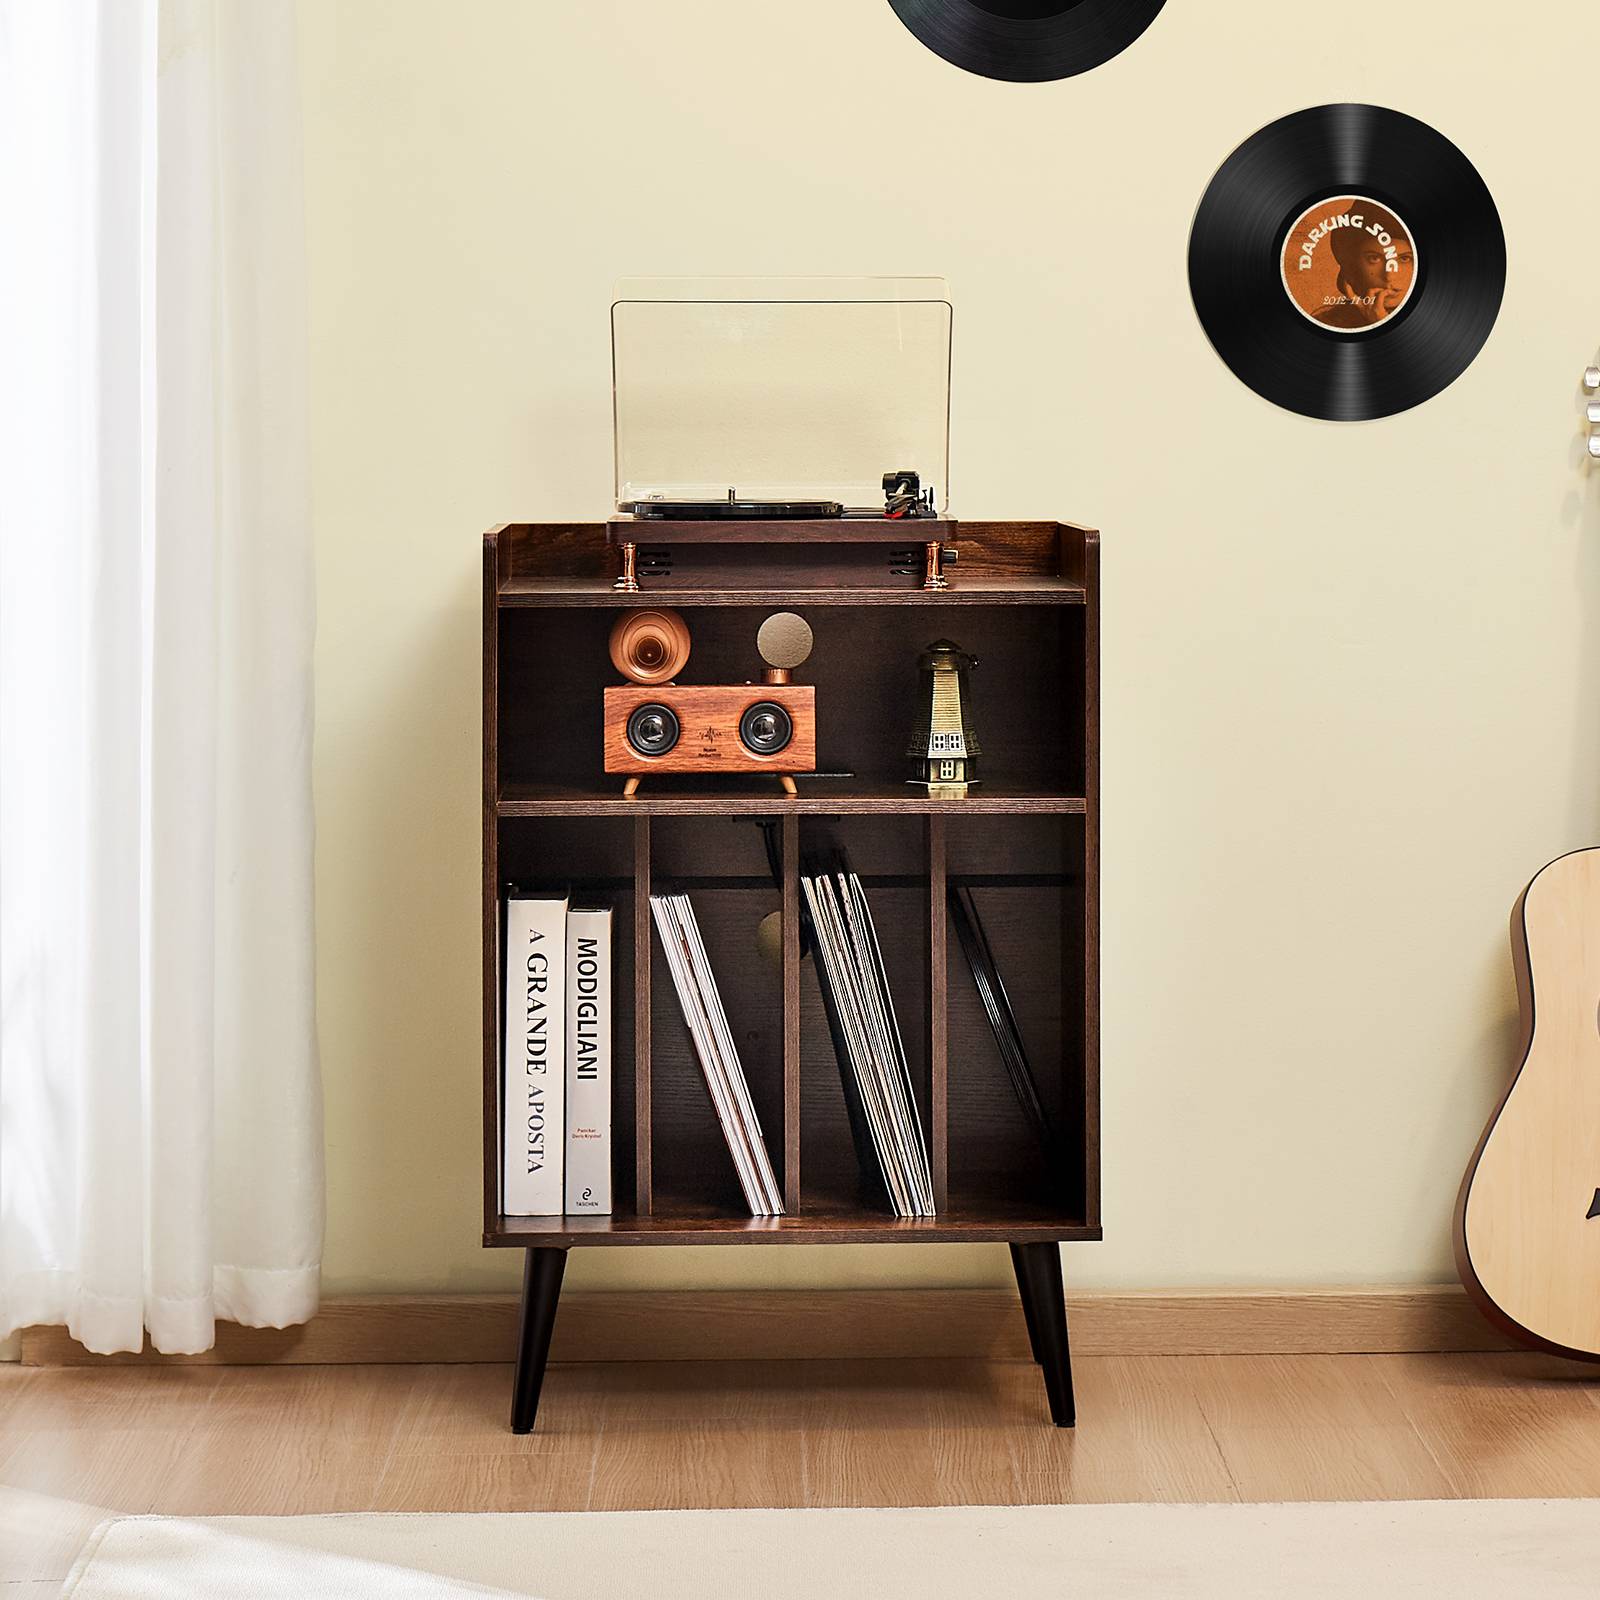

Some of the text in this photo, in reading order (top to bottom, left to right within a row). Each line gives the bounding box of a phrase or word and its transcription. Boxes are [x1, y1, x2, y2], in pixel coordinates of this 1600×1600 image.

[1298, 214, 1399, 273] DARKING SONG
[1322, 295, 1377, 306] 2012-11-01
[526, 929, 549, 1174] A GRANDE APOSTA
[577, 937, 598, 1080] MODIGLIANI
